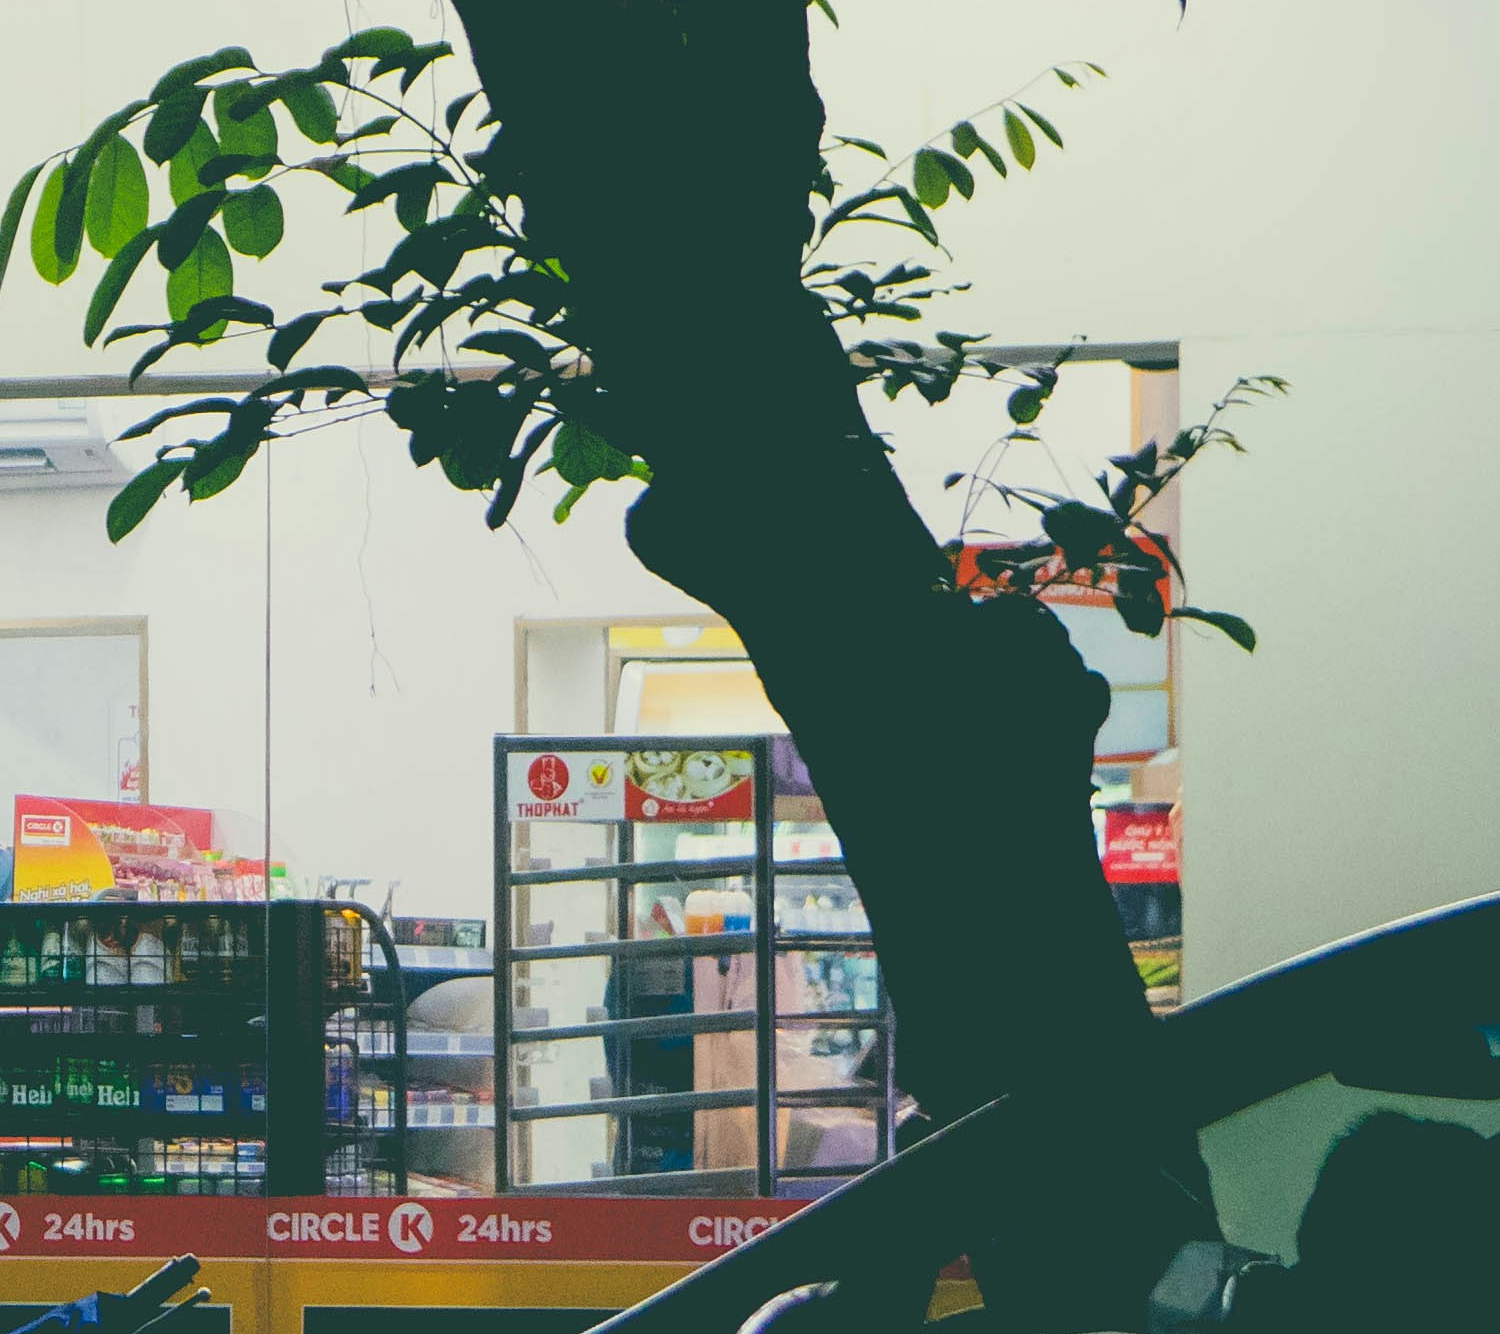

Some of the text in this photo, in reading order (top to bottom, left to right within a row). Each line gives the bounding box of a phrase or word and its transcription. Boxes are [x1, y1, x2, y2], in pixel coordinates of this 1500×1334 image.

[43, 1212, 136, 1240] 24hrs
[266, 1207, 553, 1249] CIRCLE K 24hrs
[688, 1215, 780, 1246] CIRC
